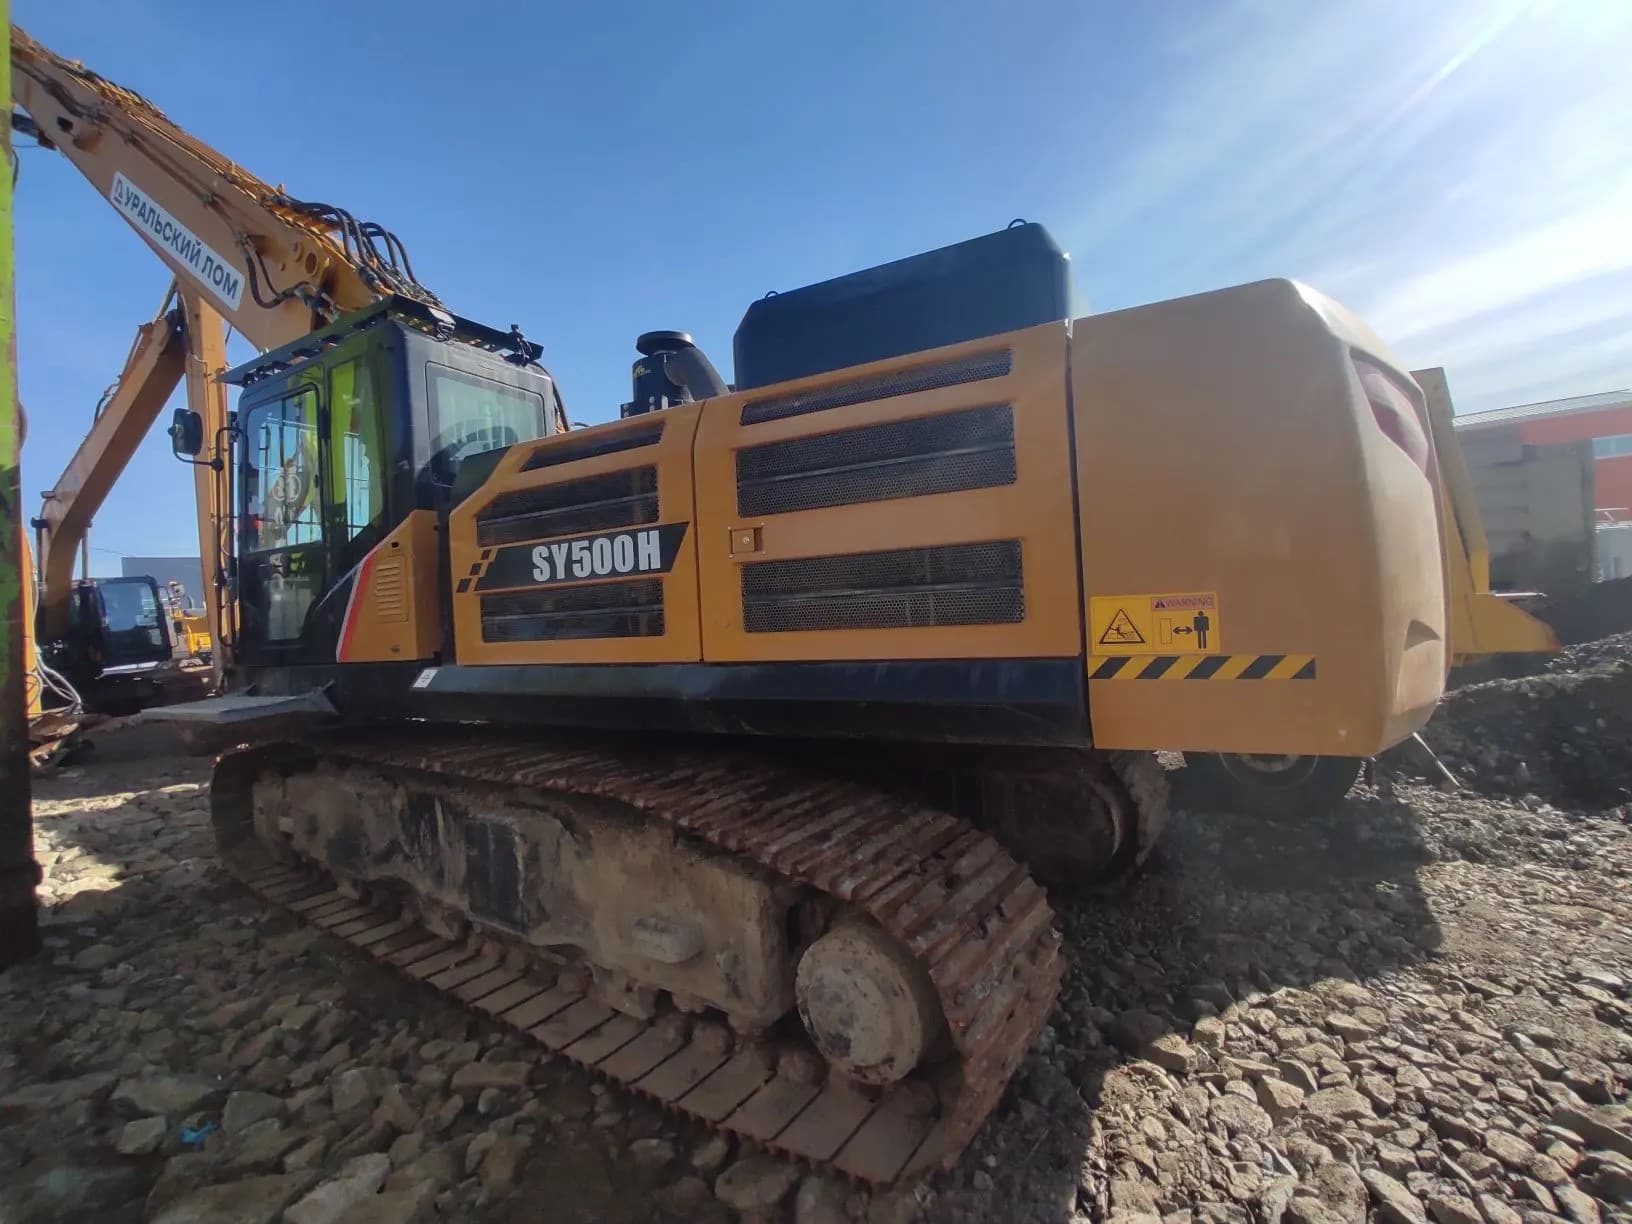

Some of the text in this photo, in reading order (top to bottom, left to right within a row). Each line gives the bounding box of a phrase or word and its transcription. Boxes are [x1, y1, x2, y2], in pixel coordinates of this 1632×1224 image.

[124, 186, 239, 300] УРАЛЬСКИЙ ЛОМ
[532, 530, 661, 582] SY500H
[1166, 597, 1213, 607] WARNING
